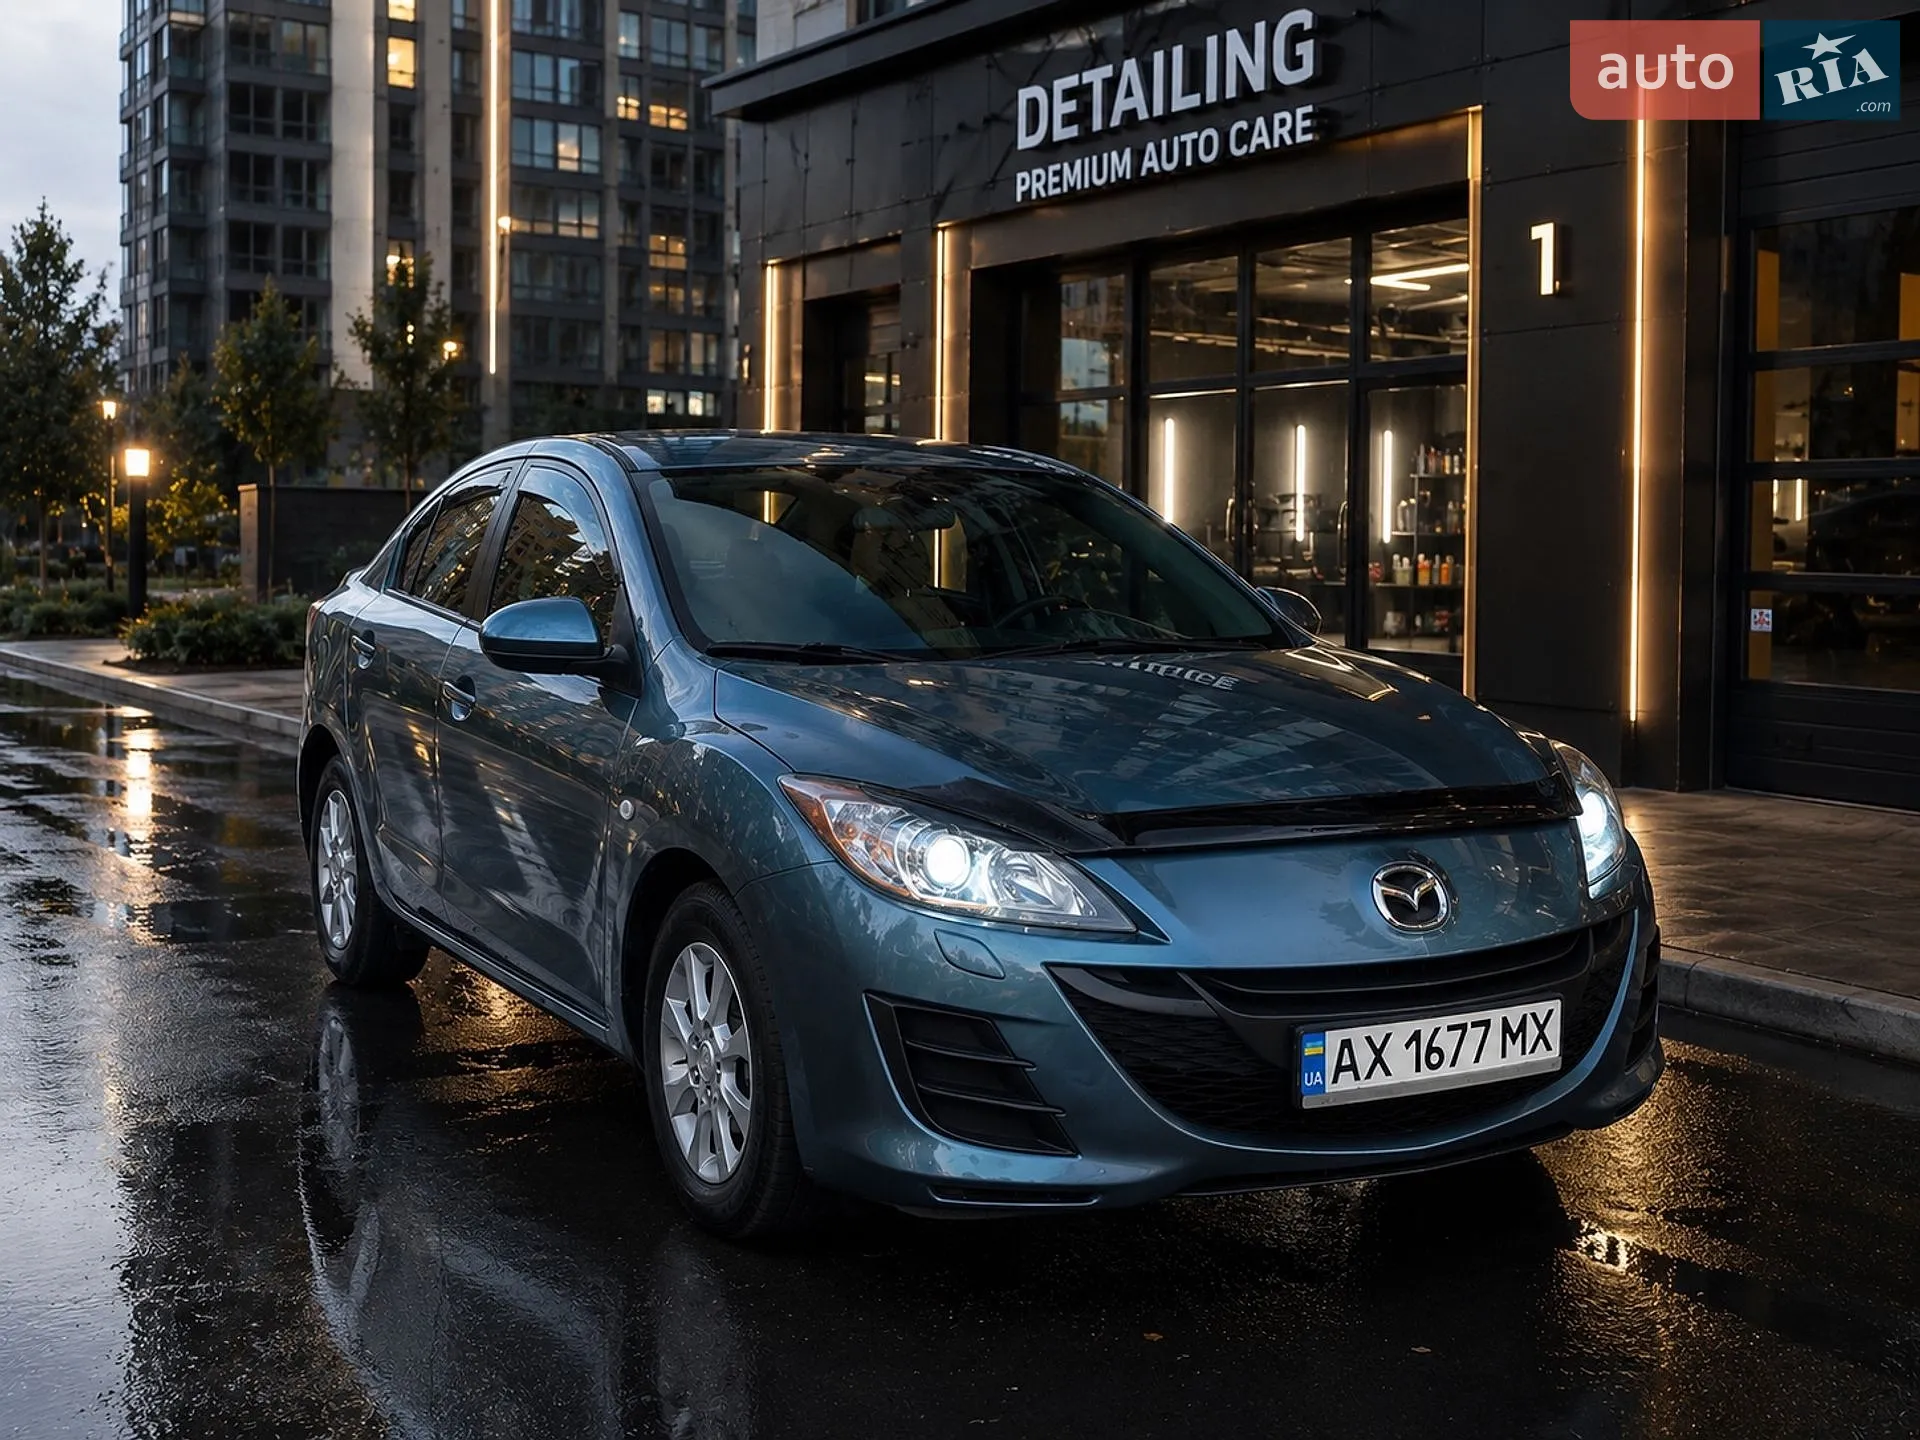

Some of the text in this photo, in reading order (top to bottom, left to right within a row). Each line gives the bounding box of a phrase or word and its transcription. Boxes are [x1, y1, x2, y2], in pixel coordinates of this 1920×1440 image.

[1016, 8, 1315, 151] DETAILING
[1015, 104, 1314, 202] PREMIUM AUTO CARE
[1529, 221, 1555, 296] 1
[1304, 1071, 1323, 1086] UA
[1331, 1008, 1554, 1085] AX 1677 MX
